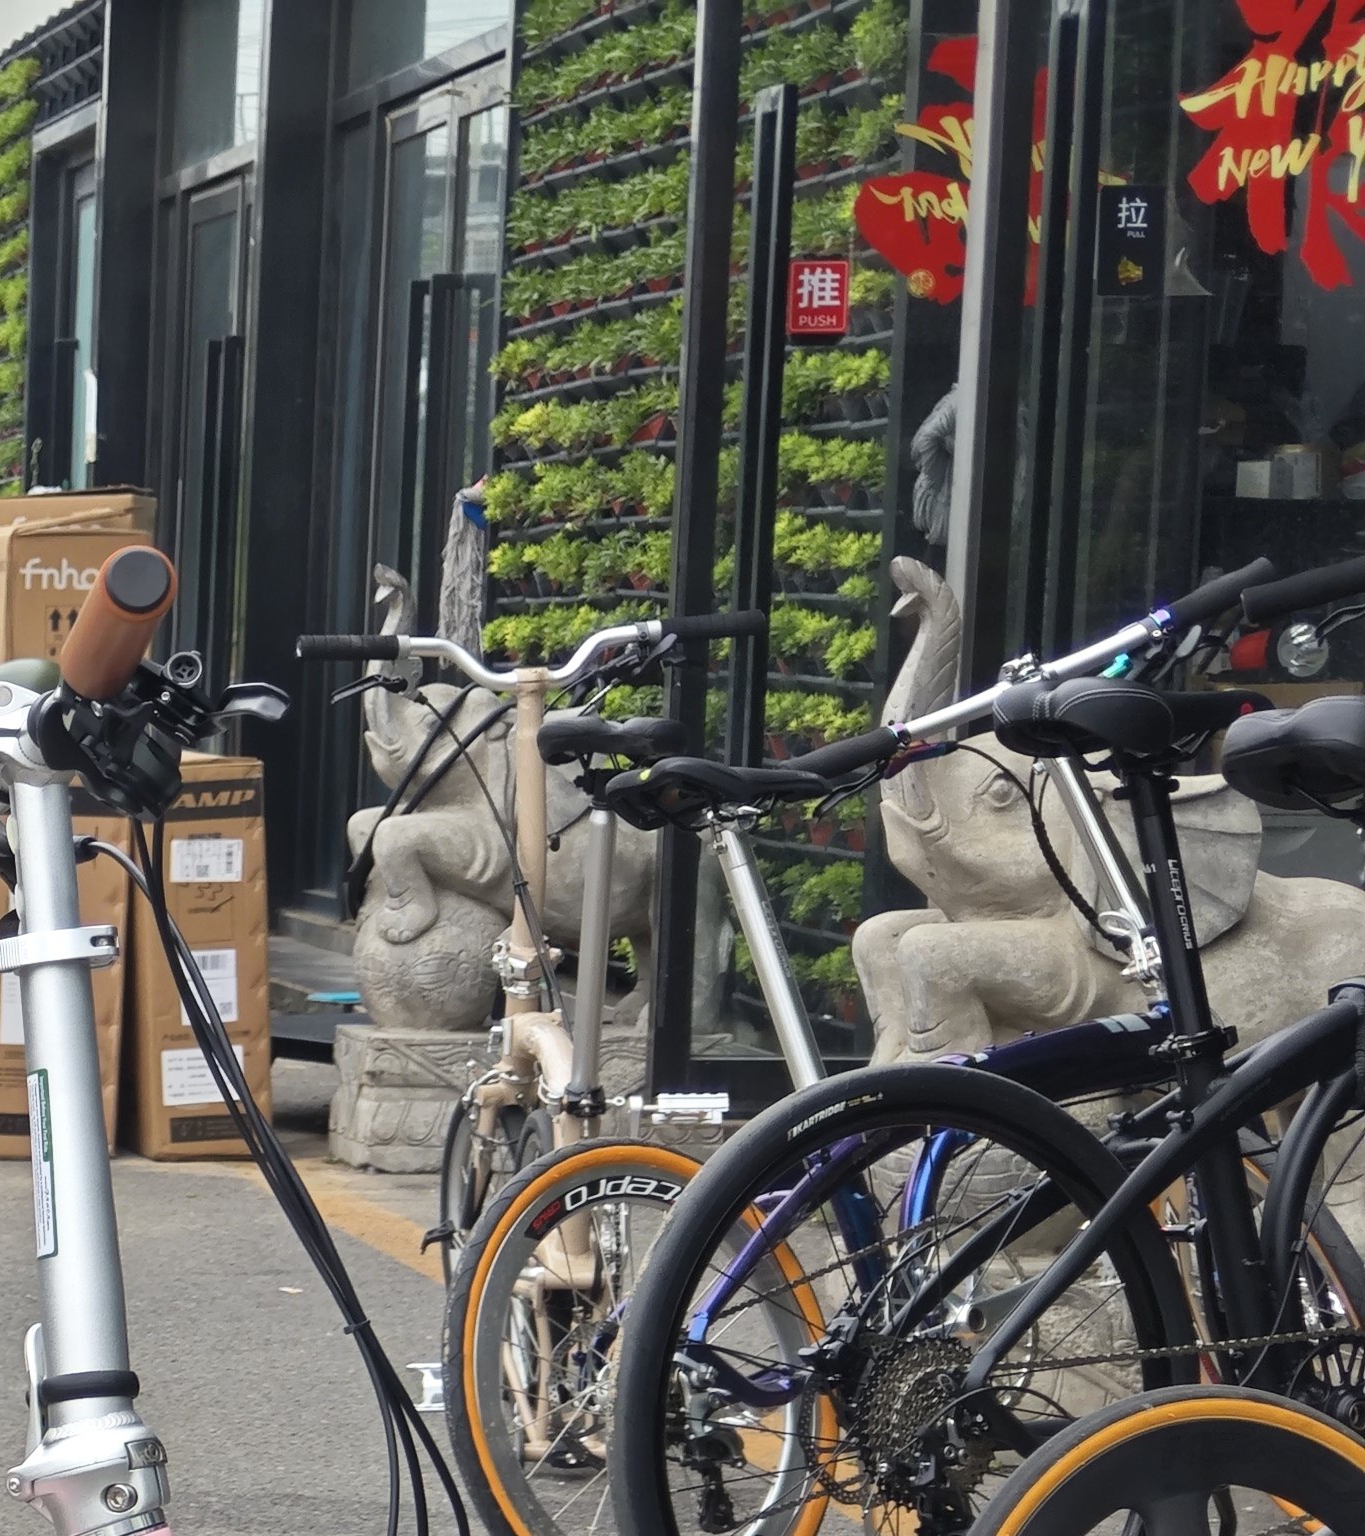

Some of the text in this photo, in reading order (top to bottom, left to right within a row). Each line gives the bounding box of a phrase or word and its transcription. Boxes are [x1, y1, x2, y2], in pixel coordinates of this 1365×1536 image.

[1117, 197, 1148, 229] 拉
[1127, 230, 1146, 239] PULL
[797, 267, 841, 308] 推
[798, 315, 837, 327] PUSH
[19, 557, 99, 591] fnho
[172, 789, 256, 809] AMP
